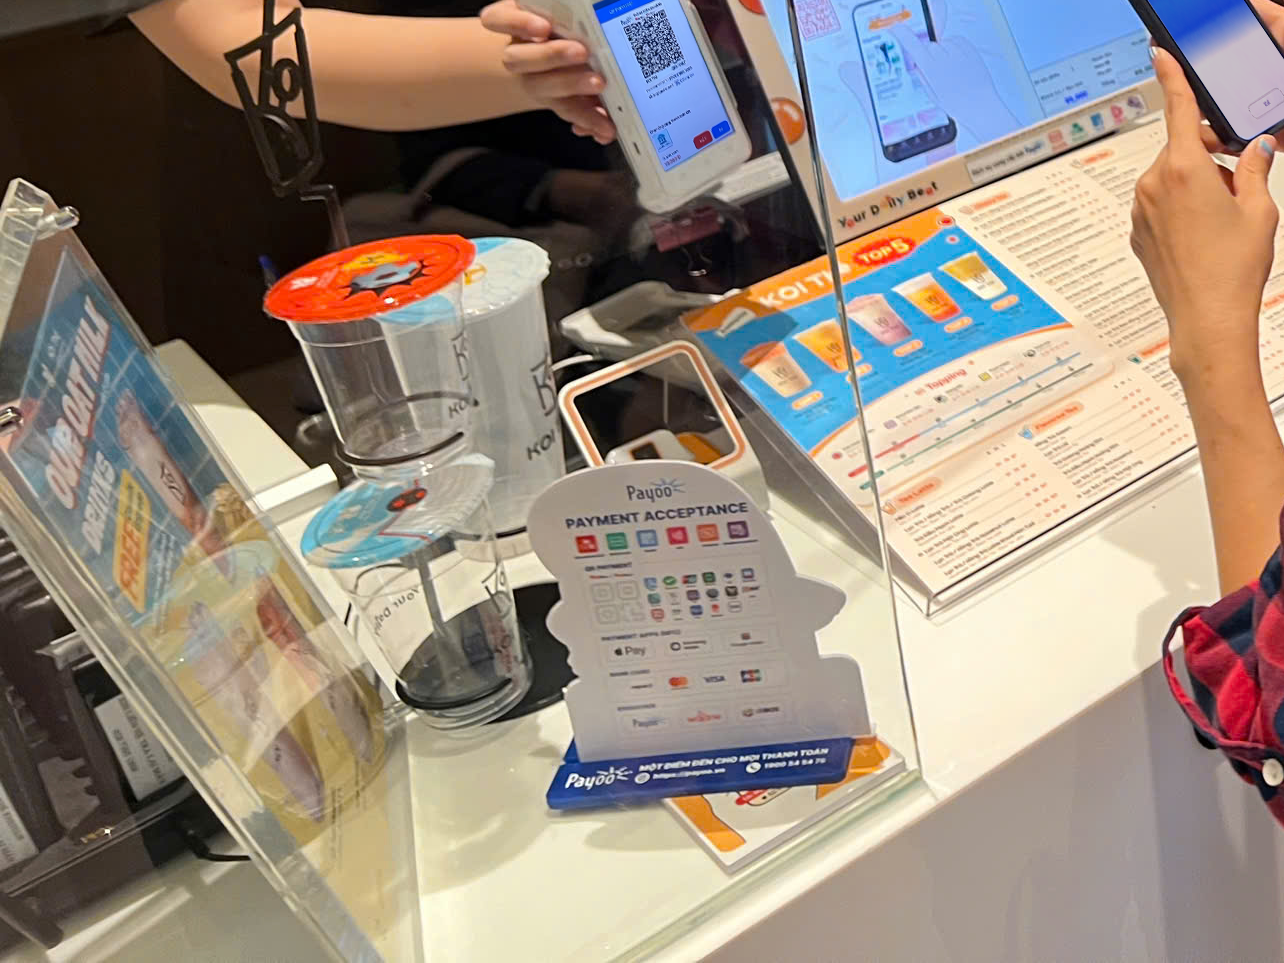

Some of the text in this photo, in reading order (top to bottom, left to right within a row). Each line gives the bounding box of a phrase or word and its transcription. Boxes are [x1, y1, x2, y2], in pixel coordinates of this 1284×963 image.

[838, 211, 866, 229] Your
[906, 180, 938, 200] Beat
[759, 280, 809, 308] KOI
[858, 245, 893, 264] TOP
[889, 238, 910, 254] 5
[73, 293, 111, 383] MILK
[925, 368, 968, 390] Topping
[60, 362, 98, 440] OAT
[527, 429, 555, 461] KOI
[626, 484, 673, 503] Payoo
[565, 502, 749, 530] PAYMENT ACCEPTANCE
[624, 646, 646, 659] Pay
[703, 675, 725, 683] VISA
[714, 755, 738, 765] CHO
[762, 750, 799, 760] THANH
[801, 748, 830, 757] TOÁN
[564, 772, 616, 791] Payoo
